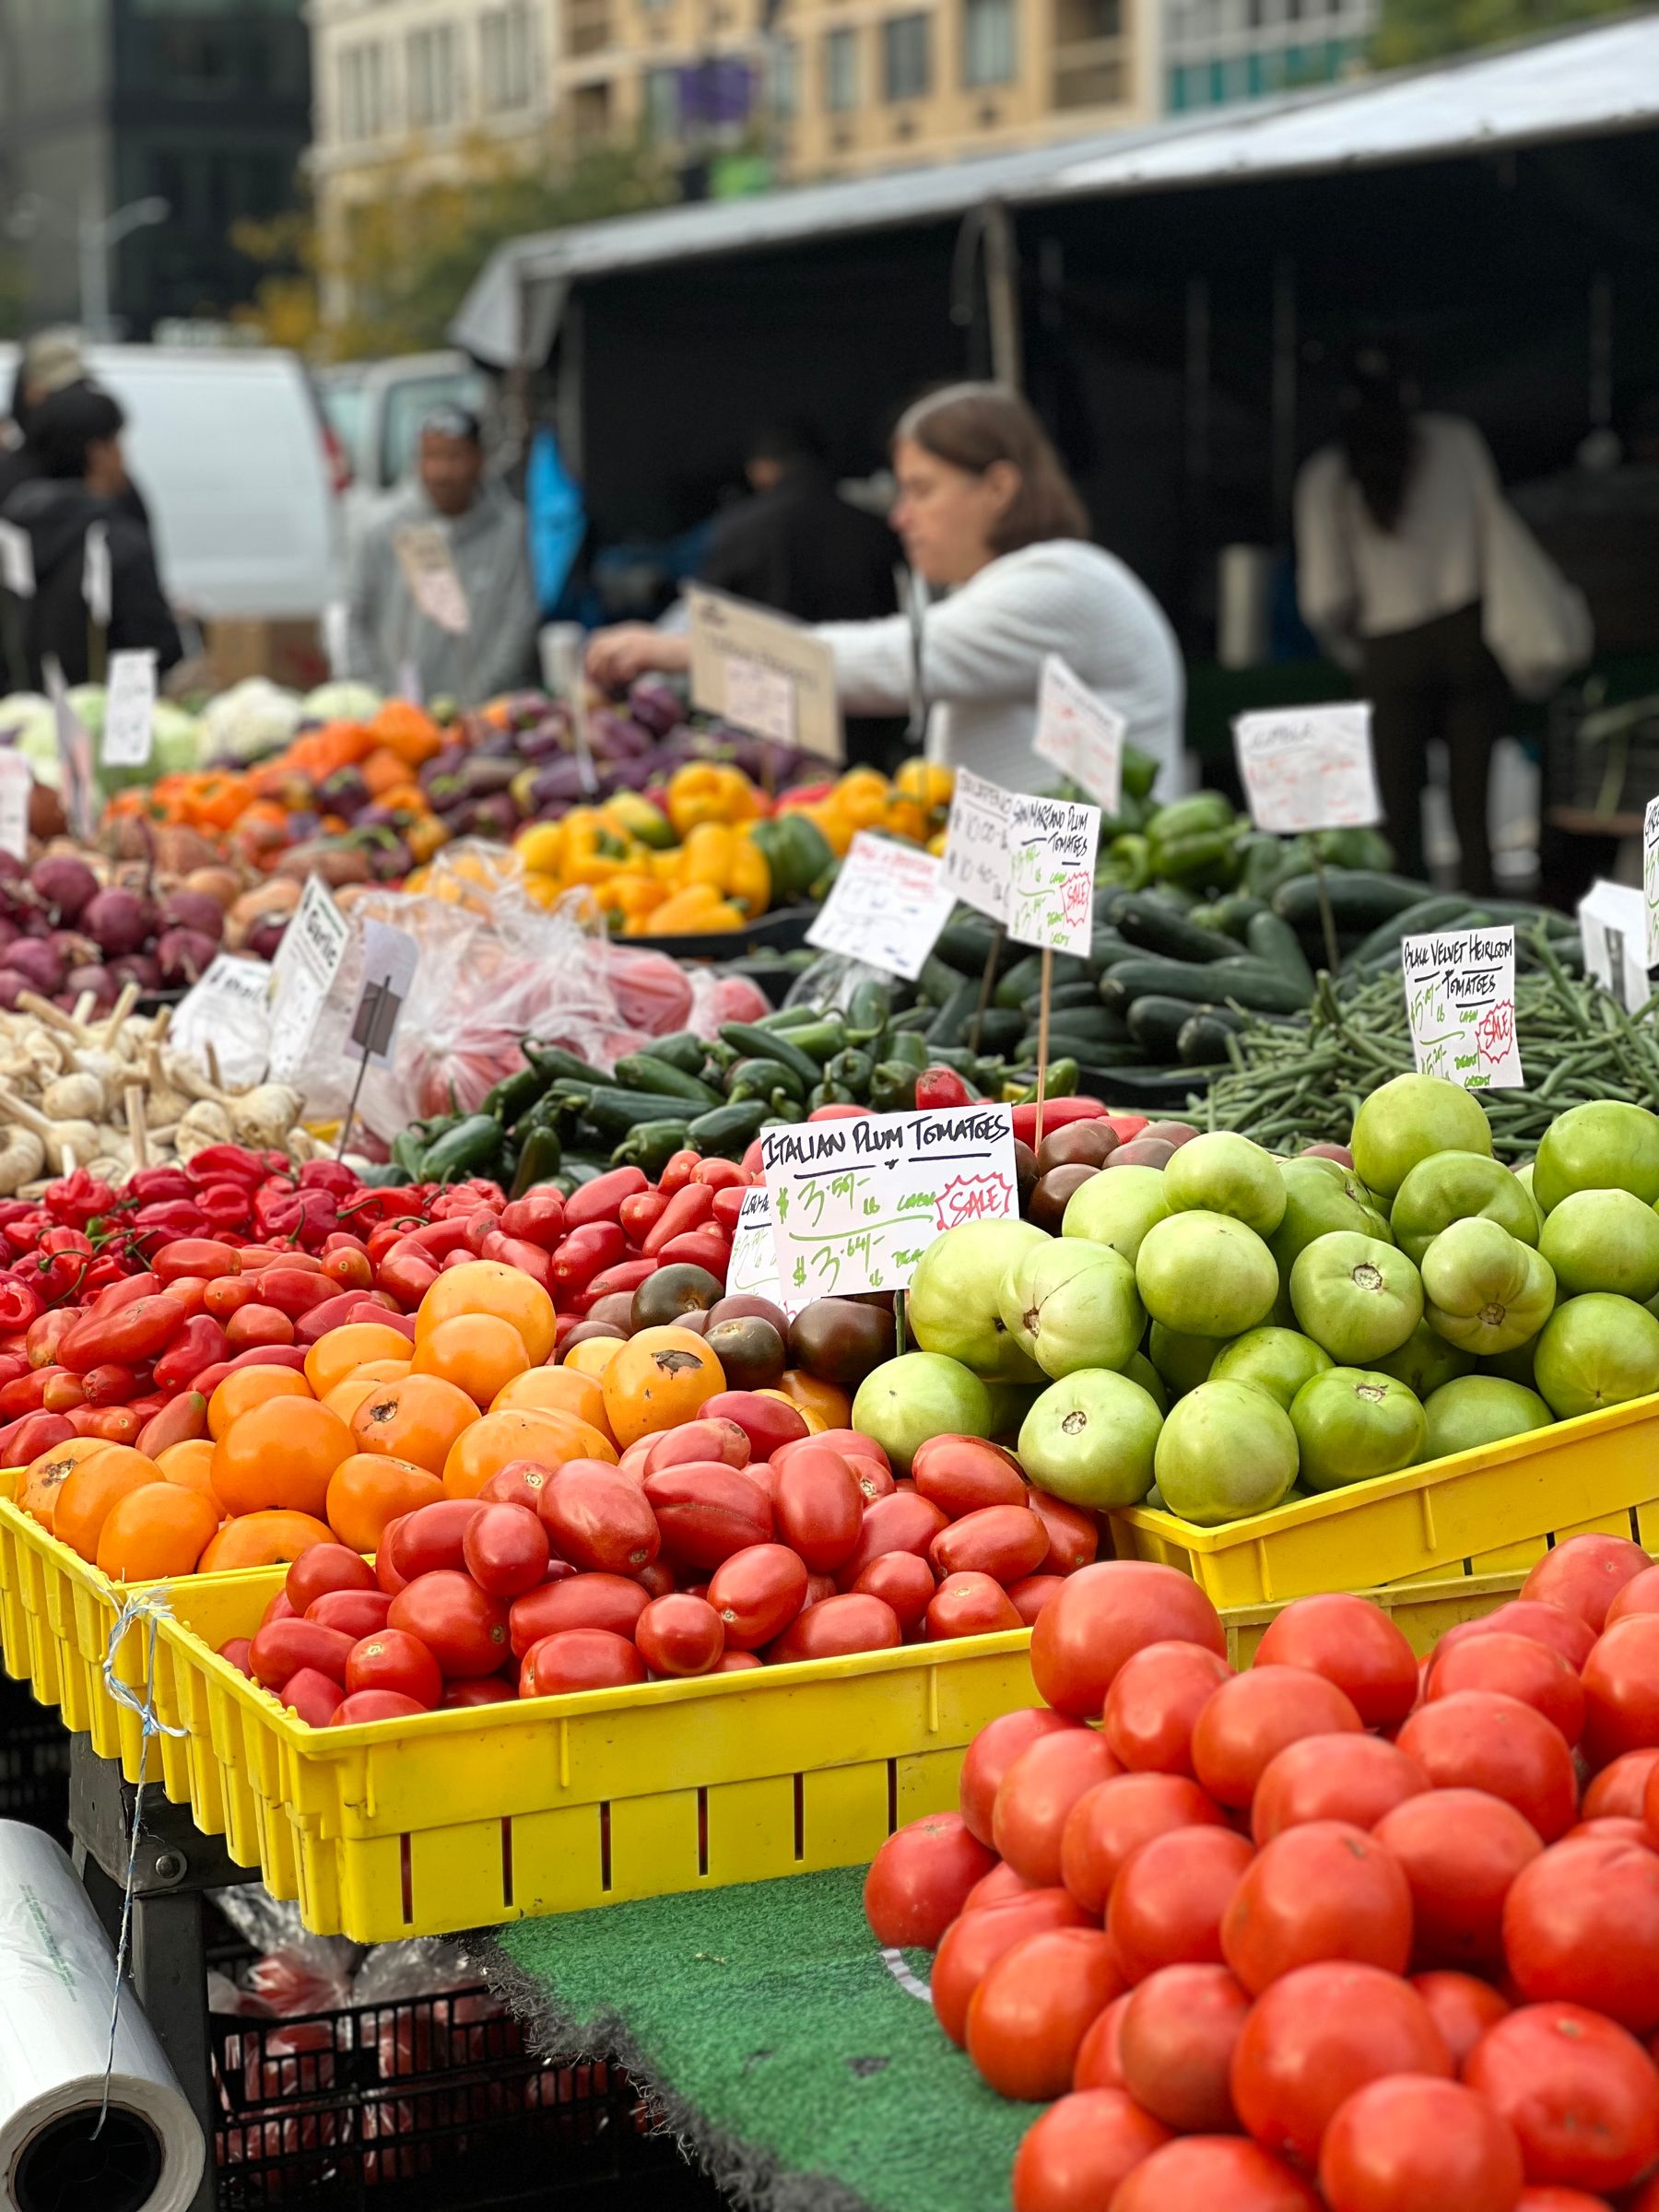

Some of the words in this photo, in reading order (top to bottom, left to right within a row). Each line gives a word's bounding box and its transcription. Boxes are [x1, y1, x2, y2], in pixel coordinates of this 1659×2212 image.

[1067, 805, 1088, 832] PLUM
[1048, 831, 1088, 857] TOMATOES
[1067, 881, 1088, 911] SALE
[1430, 939, 1467, 966] VELVET
[1469, 934, 1512, 962] HEIRLOOM
[1441, 973, 1496, 1000] TOMATOES
[1459, 1009, 1478, 1023] CASH
[1484, 1011, 1510, 1050] SALE
[762, 1132, 846, 1171] ITALIAN
[852, 1121, 903, 1154] PLUM
[907, 1112, 1011, 1150] TOMATOES
[948, 1183, 1003, 1228] SALE
